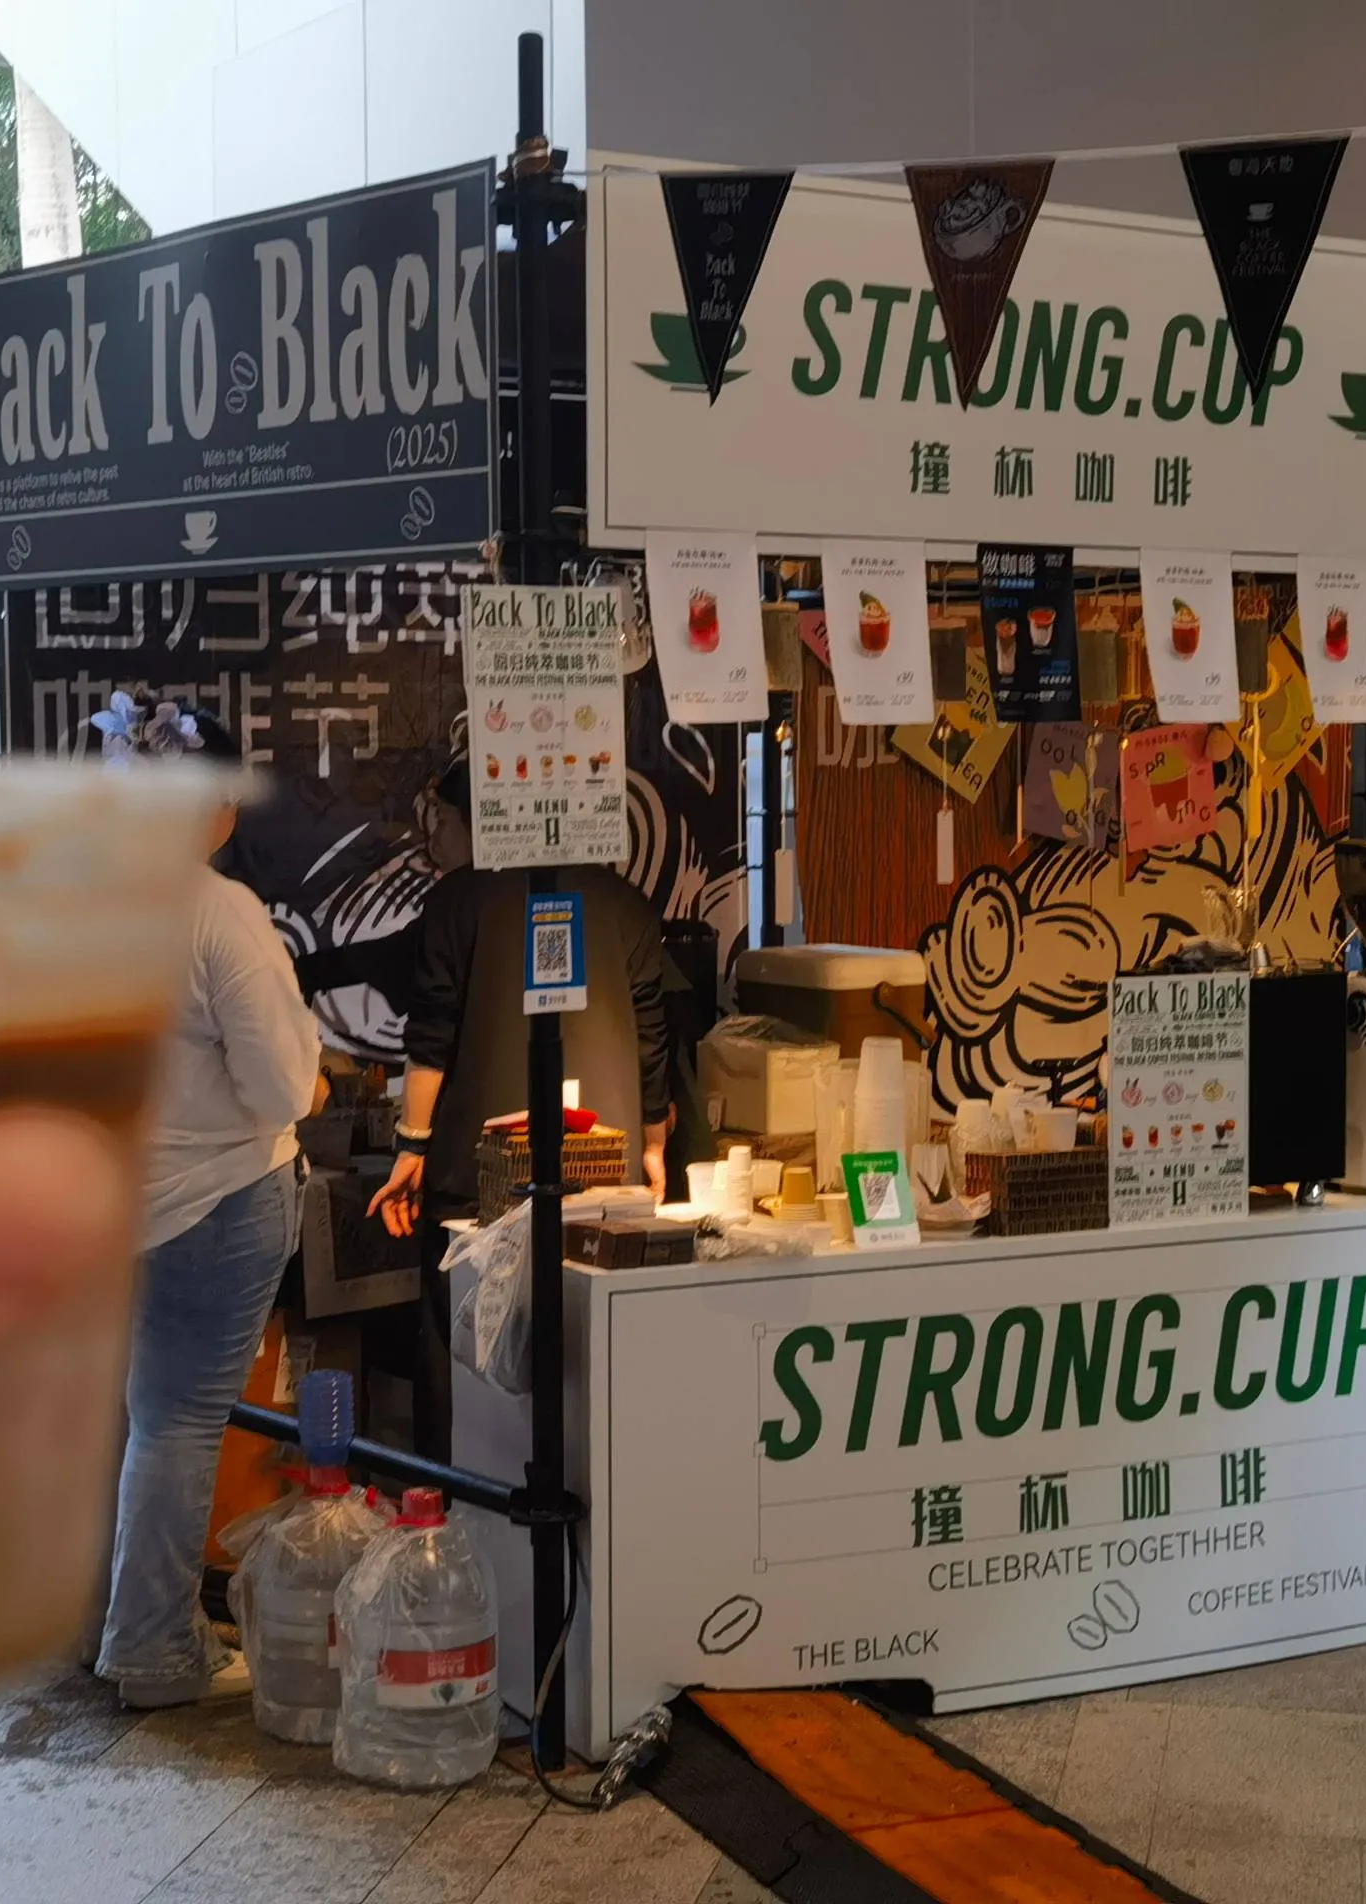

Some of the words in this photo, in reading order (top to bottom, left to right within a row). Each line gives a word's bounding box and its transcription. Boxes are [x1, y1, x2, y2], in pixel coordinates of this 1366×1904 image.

[705, 252, 736, 277] Back
[138, 262, 218, 445] To
[254, 188, 488, 430] Black
[700, 299, 737, 321] Black
[791, 279, 1305, 426] STRONG.CUP
[203, 449, 226, 468] With
[227, 448, 244, 464] the
[386, 419, 459, 475] (2025)
[13, 473, 48, 494] platform
[83, 467, 98, 482] the
[183, 476, 193, 492] at
[194, 475, 210, 490] the
[211, 471, 237, 489] heart
[238, 468, 250, 487] of
[251, 465, 285, 485] British
[909, 441, 1194, 508] 撞杯咖啡
[471, 590, 522, 629] Back
[532, 592, 555, 628] To
[565, 591, 617, 628] Black
[534, 800, 569, 815] MENU
[1112, 981, 1159, 1016] Back
[1168, 981, 1188, 1012] To
[1198, 977, 1247, 1012] Black
[1163, 1163, 1195, 1178] MENU
[911, 1448, 1267, 1548] 撞杯咖啡
[928, 1545, 1092, 1593] CELEBRATE
[1100, 1520, 1266, 1575] TOGETHHER
[1188, 1580, 1274, 1617] COFFEE
[792, 1639, 846, 1672] THE
[854, 1627, 940, 1665] BLACK
